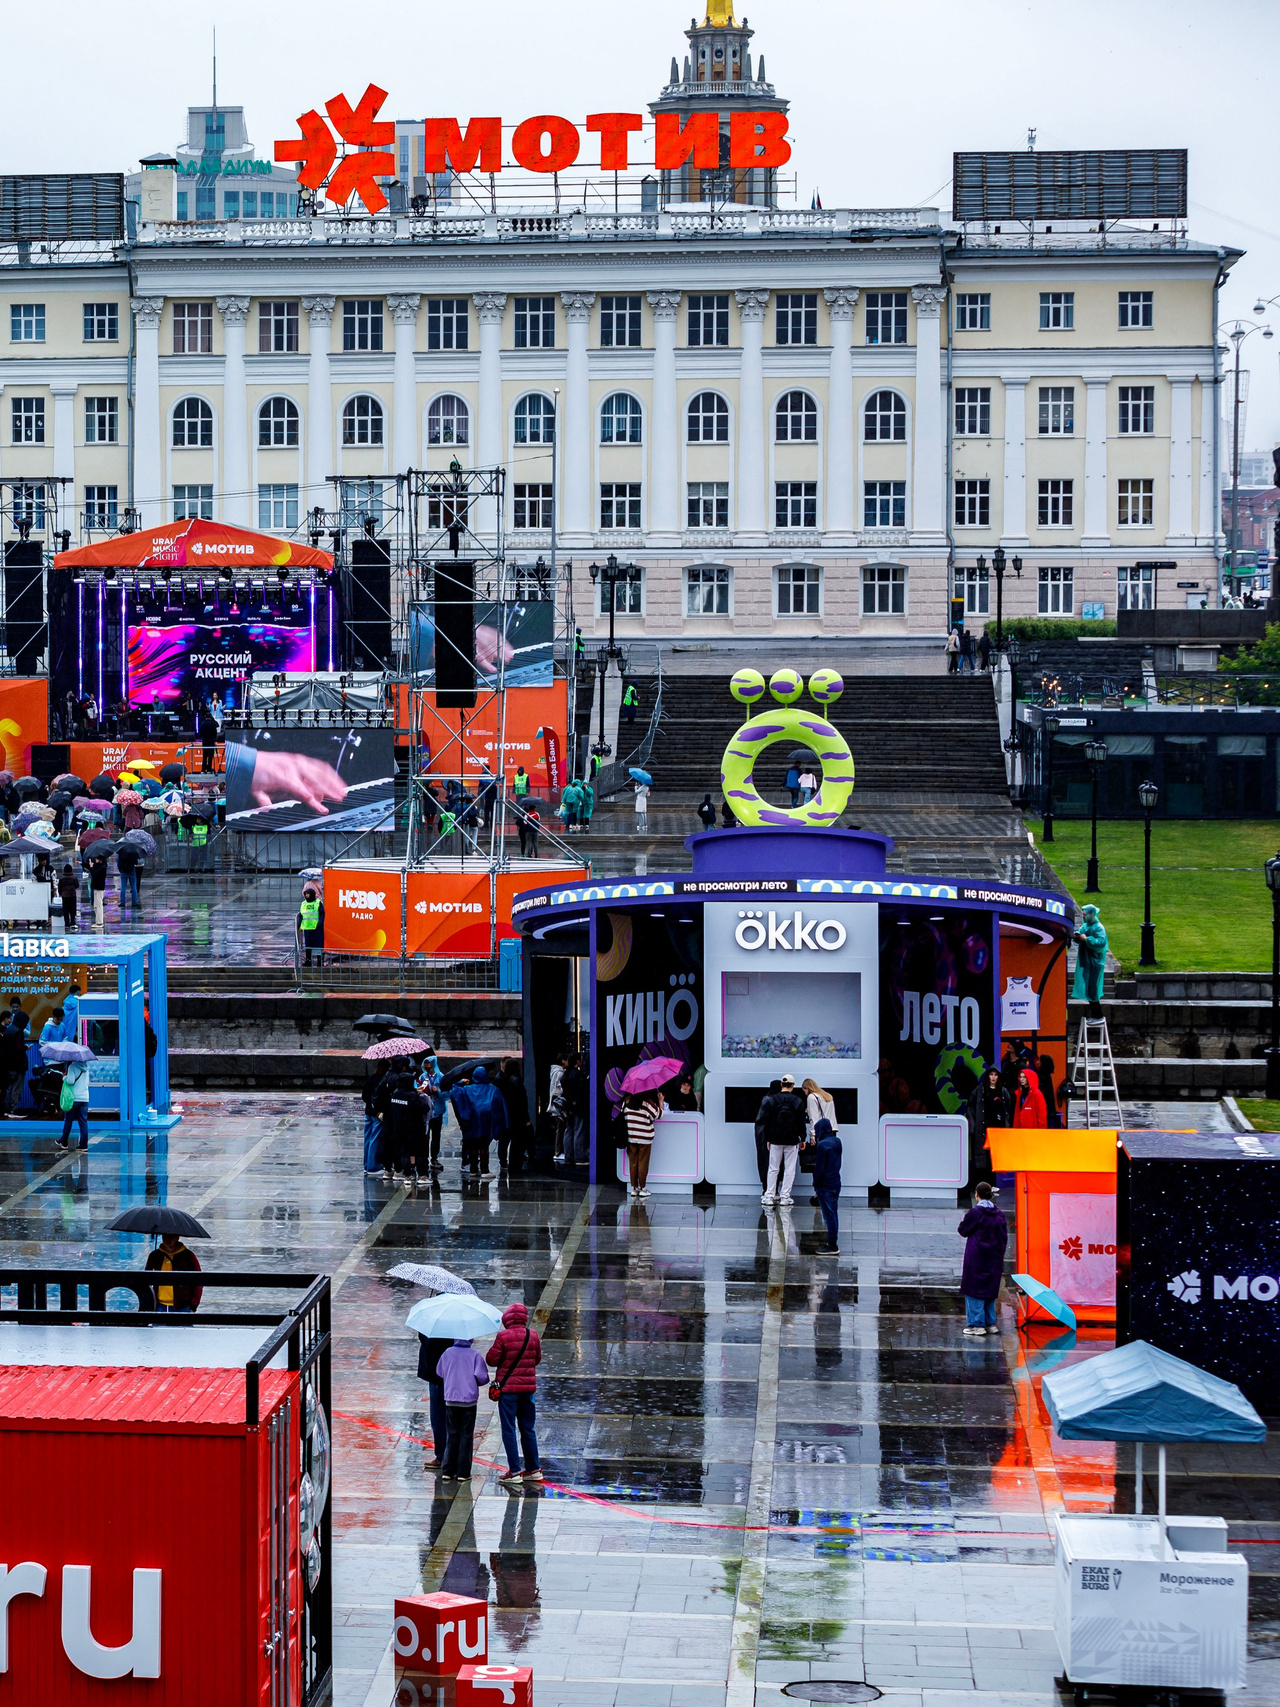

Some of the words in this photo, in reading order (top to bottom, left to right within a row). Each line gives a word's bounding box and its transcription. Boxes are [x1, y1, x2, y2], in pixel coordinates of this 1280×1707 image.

[424, 111, 792, 173] МОТИВ
[163, 160, 272, 174] АЛЛАДИУМ
[205, 544, 254, 554] МОТИВ
[190, 650, 252, 664] РУССКИЙ
[195, 668, 247, 679] АКЦЕНТ
[550, 763, 558, 793] Альфа
[684, 883, 696, 891] не
[698, 882, 759, 893] просмотри
[761, 881, 788, 890] лето
[338, 890, 386, 910] НОВОЕ
[534, 896, 547, 906] лето
[964, 889, 977, 898] не
[978, 890, 1026, 906] просмотри
[1026, 897, 1042, 908] лето
[430, 903, 483, 913] МОТИВ
[352, 912, 373, 920] РАДИО
[30, 985, 58, 994] днём
[1214, 1275, 1280, 1301] МО
[1160, 1572, 1235, 1586] Мороженое
[1174, 1587, 1199, 1595] Cream
[394, 1616, 486, 1663] o.ru
